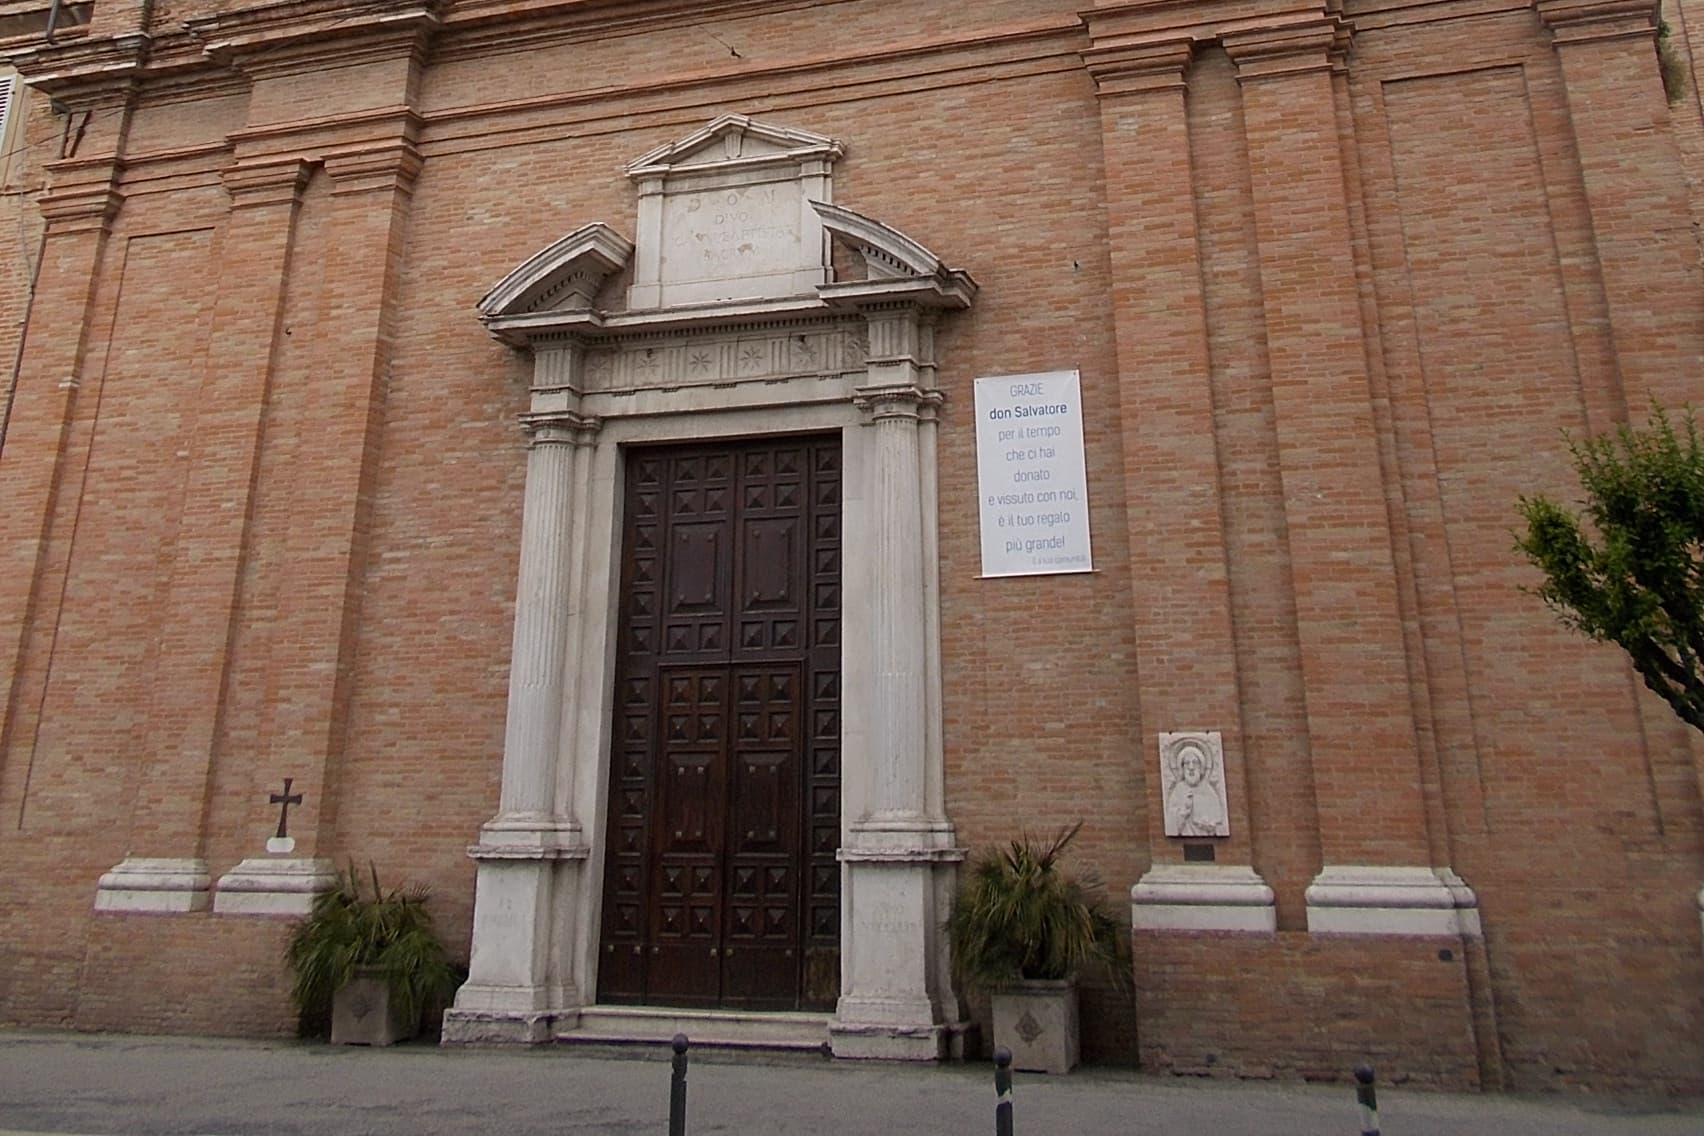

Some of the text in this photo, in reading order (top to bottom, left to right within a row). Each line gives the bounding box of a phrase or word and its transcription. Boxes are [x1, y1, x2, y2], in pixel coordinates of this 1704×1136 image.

[1009, 382, 1044, 398] GRAZIE
[989, 403, 1068, 420] don Salvatore
[998, 425, 1061, 442] per il tempo
[1006, 446, 1056, 462] che ci hai
[1014, 469, 1050, 483] donato
[988, 495, 996, 506] e
[997, 492, 1034, 505] vissuto
[1036, 491, 1057, 503] con
[1008, 513, 1015, 527] il
[1017, 514, 1035, 526] tuo
[1037, 511, 1071, 527] regalo
[1006, 538, 1022, 554] più
